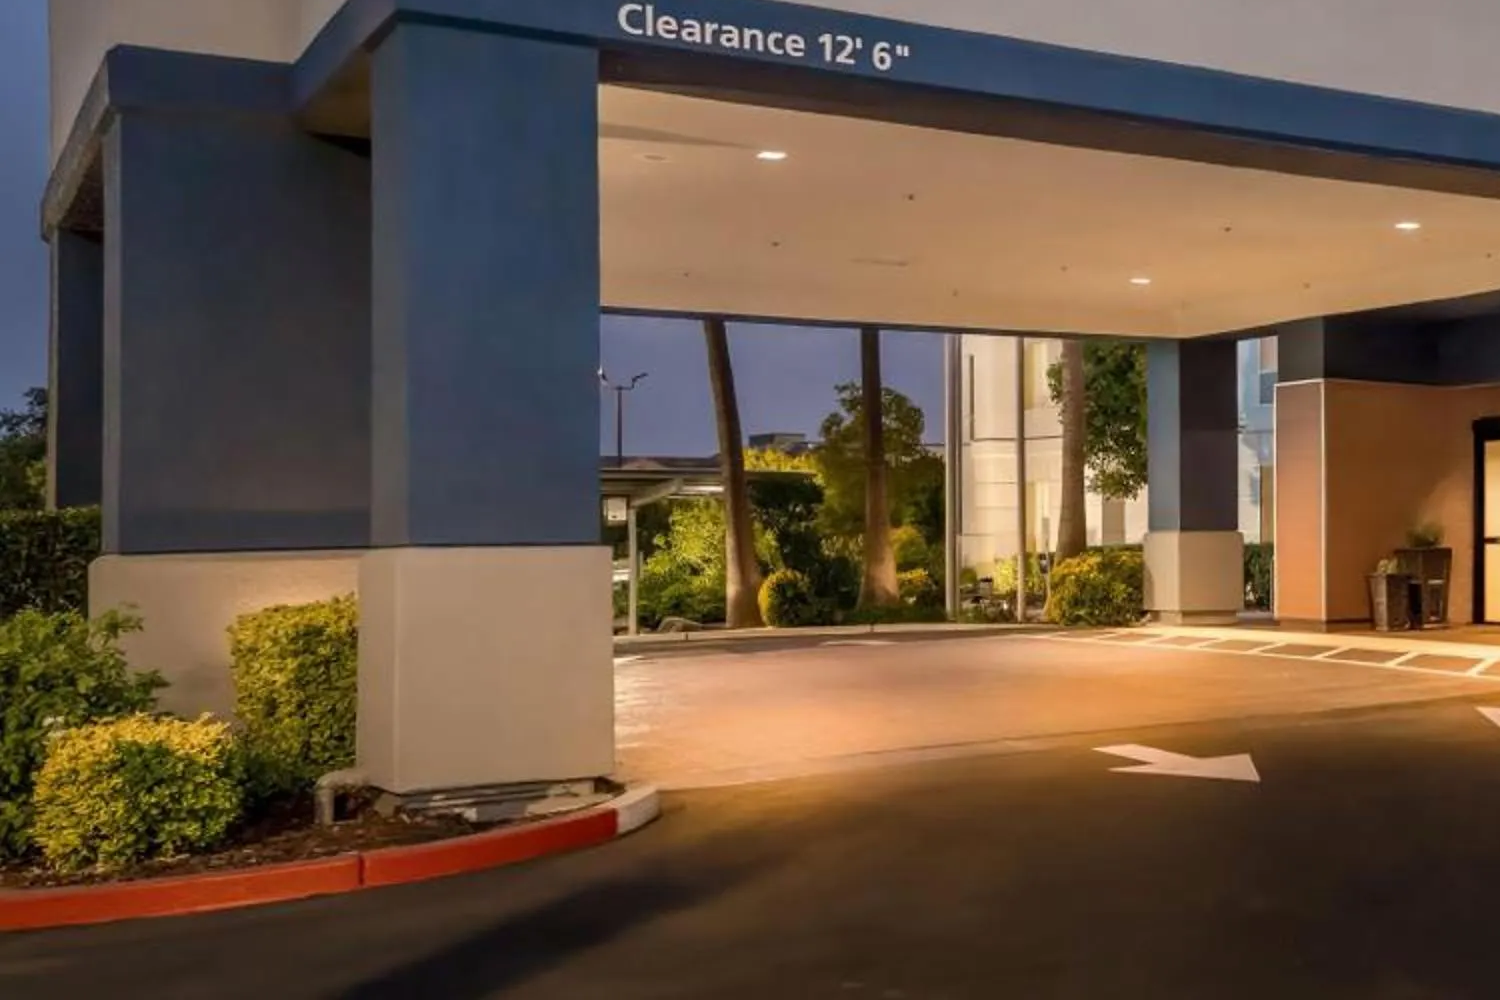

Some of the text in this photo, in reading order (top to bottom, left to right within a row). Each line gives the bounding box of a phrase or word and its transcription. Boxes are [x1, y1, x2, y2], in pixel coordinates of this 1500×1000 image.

[616, 3, 910, 72] Clearance 12' 6"
